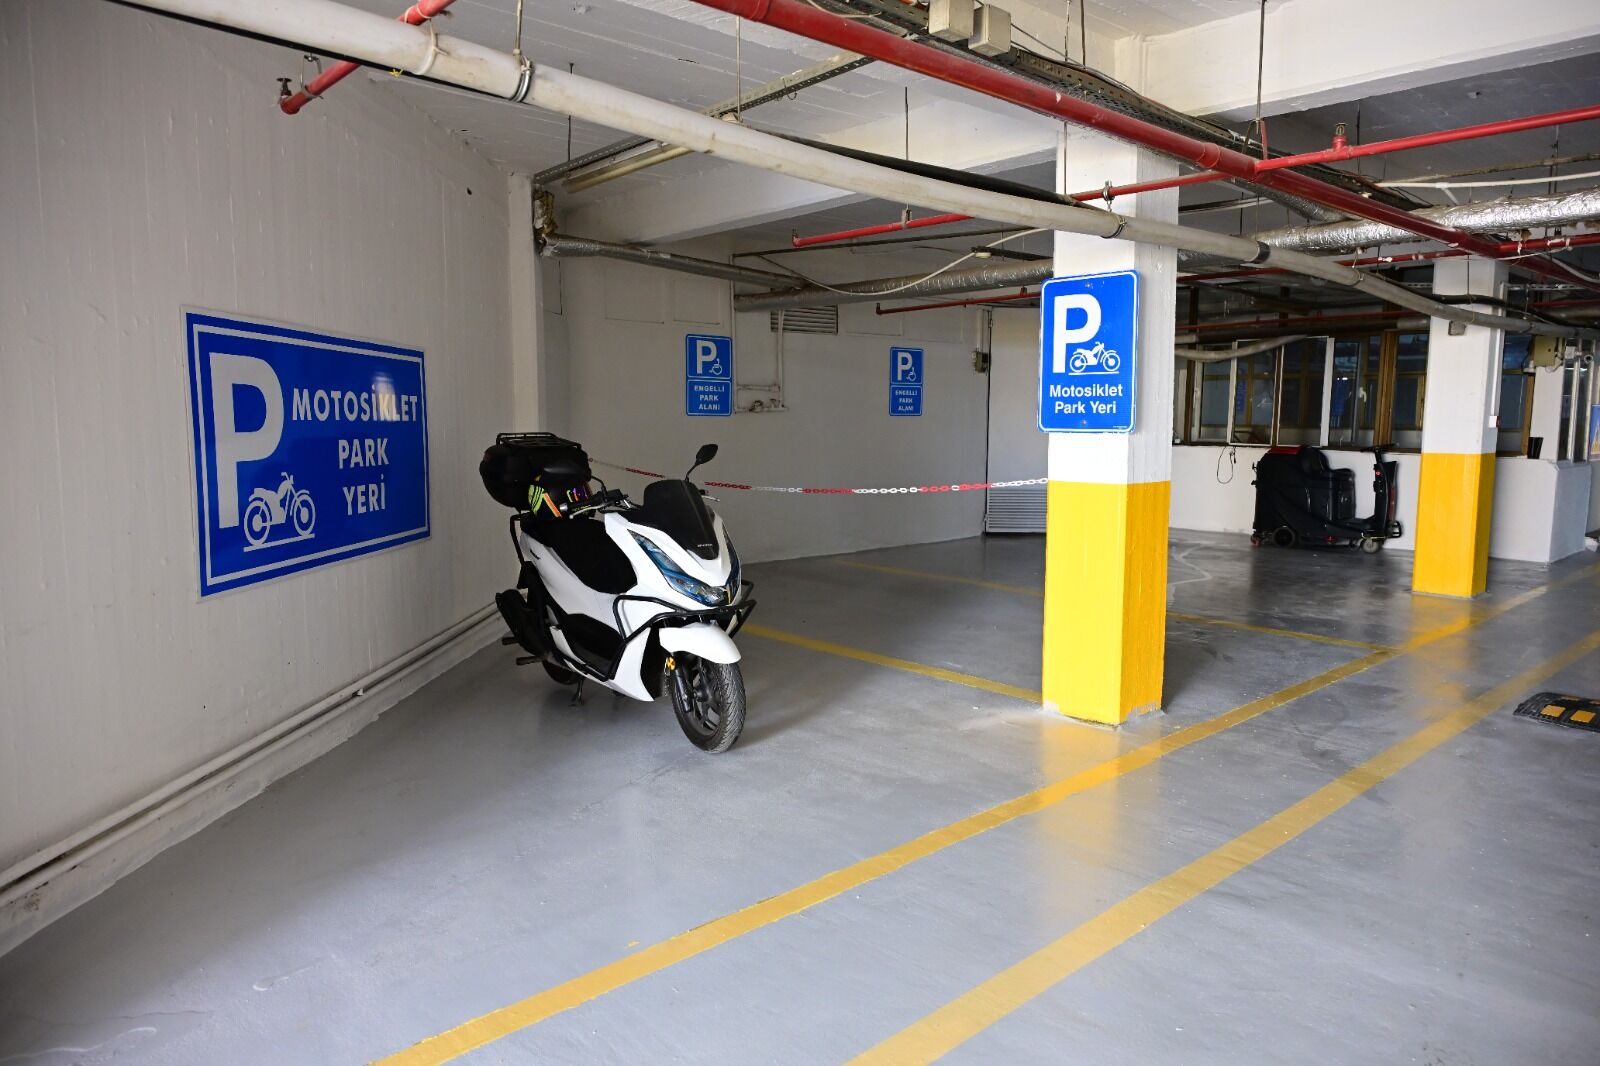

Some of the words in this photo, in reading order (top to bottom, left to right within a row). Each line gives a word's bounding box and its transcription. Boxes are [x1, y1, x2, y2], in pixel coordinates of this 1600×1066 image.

[1052, 293, 1102, 374] P
[696, 339, 717, 374] P
[897, 351, 913, 381] P
[292, 384, 418, 422] MOTOSİKLET
[1049, 383, 1123, 397] Motosiklet
[1054, 401, 1086, 414] Park
[1090, 400, 1117, 414] Yeri
[209, 352, 284, 529] P
[338, 437, 389, 469] PARK
[342, 475, 386, 516] YERİ
